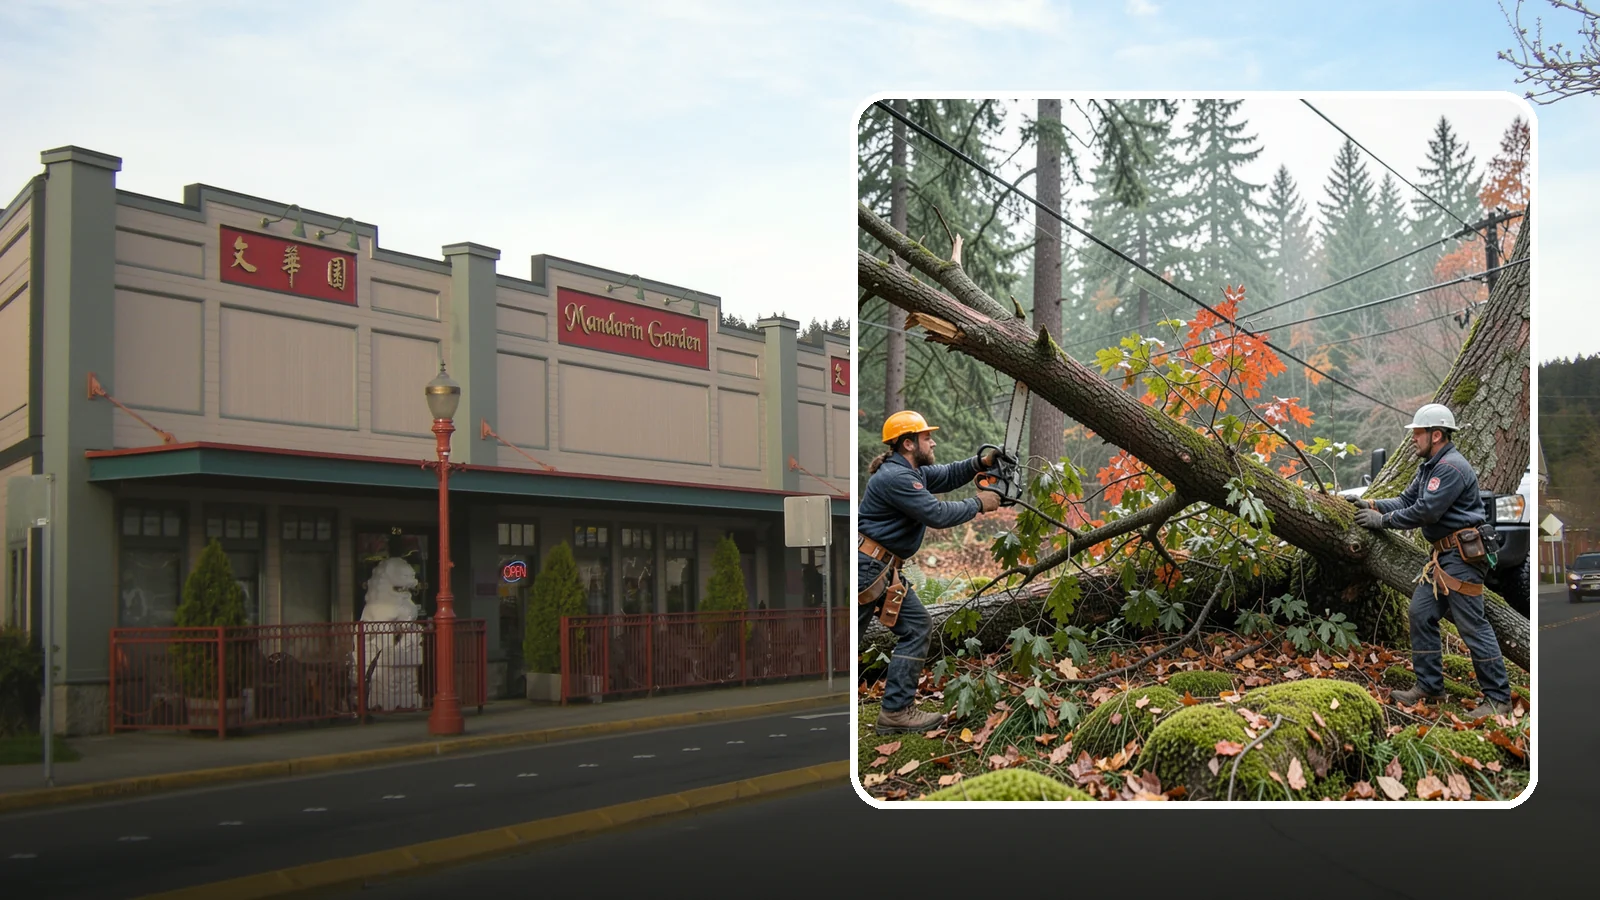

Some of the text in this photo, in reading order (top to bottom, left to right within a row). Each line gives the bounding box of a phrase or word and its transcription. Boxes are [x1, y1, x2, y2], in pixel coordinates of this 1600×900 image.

[231, 236, 346, 291] 文華園
[565, 302, 701, 352] Mandarin Garden
[503, 565, 527, 578] OPEN
